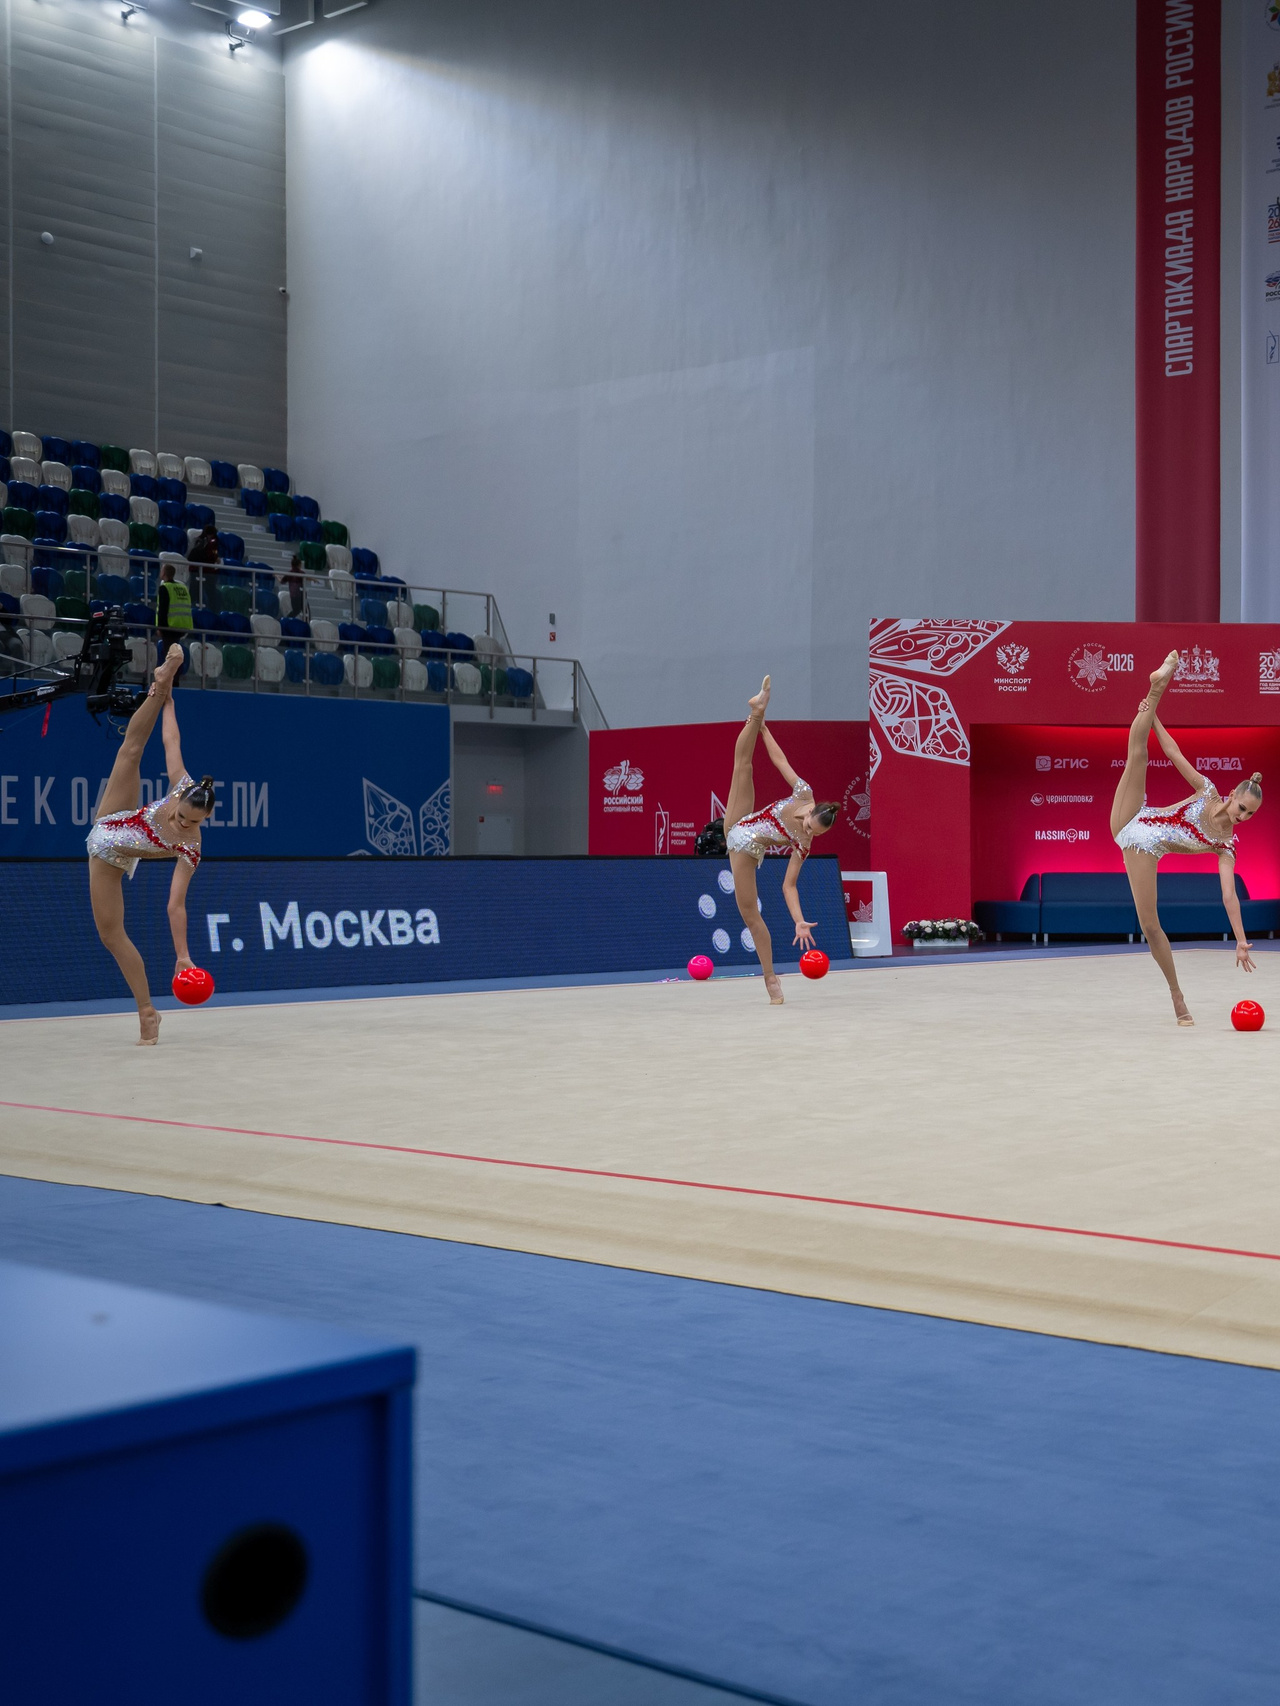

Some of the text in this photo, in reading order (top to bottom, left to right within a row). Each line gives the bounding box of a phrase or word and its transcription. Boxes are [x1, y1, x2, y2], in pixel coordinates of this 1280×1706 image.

[1165, 95, 1194, 203] НАРОДОВ
[1268, 207, 1280, 218] 20
[1268, 218, 1280, 230] 26
[1165, 208, 1194, 377] СПАРТАКИАДА
[1107, 653, 1134, 672] 2026
[1259, 655, 1275, 668] 20
[1259, 668, 1275, 680] 26
[1054, 758, 1089, 769] 2ГИС
[1110, 759, 1174, 768] ДО ИЦЦА
[35, 776, 57, 826] К
[208, 780, 269, 828] ЕЛИ
[604, 794, 643, 805] РОССИЙСКИЙ
[206, 901, 440, 952] г. Москва
